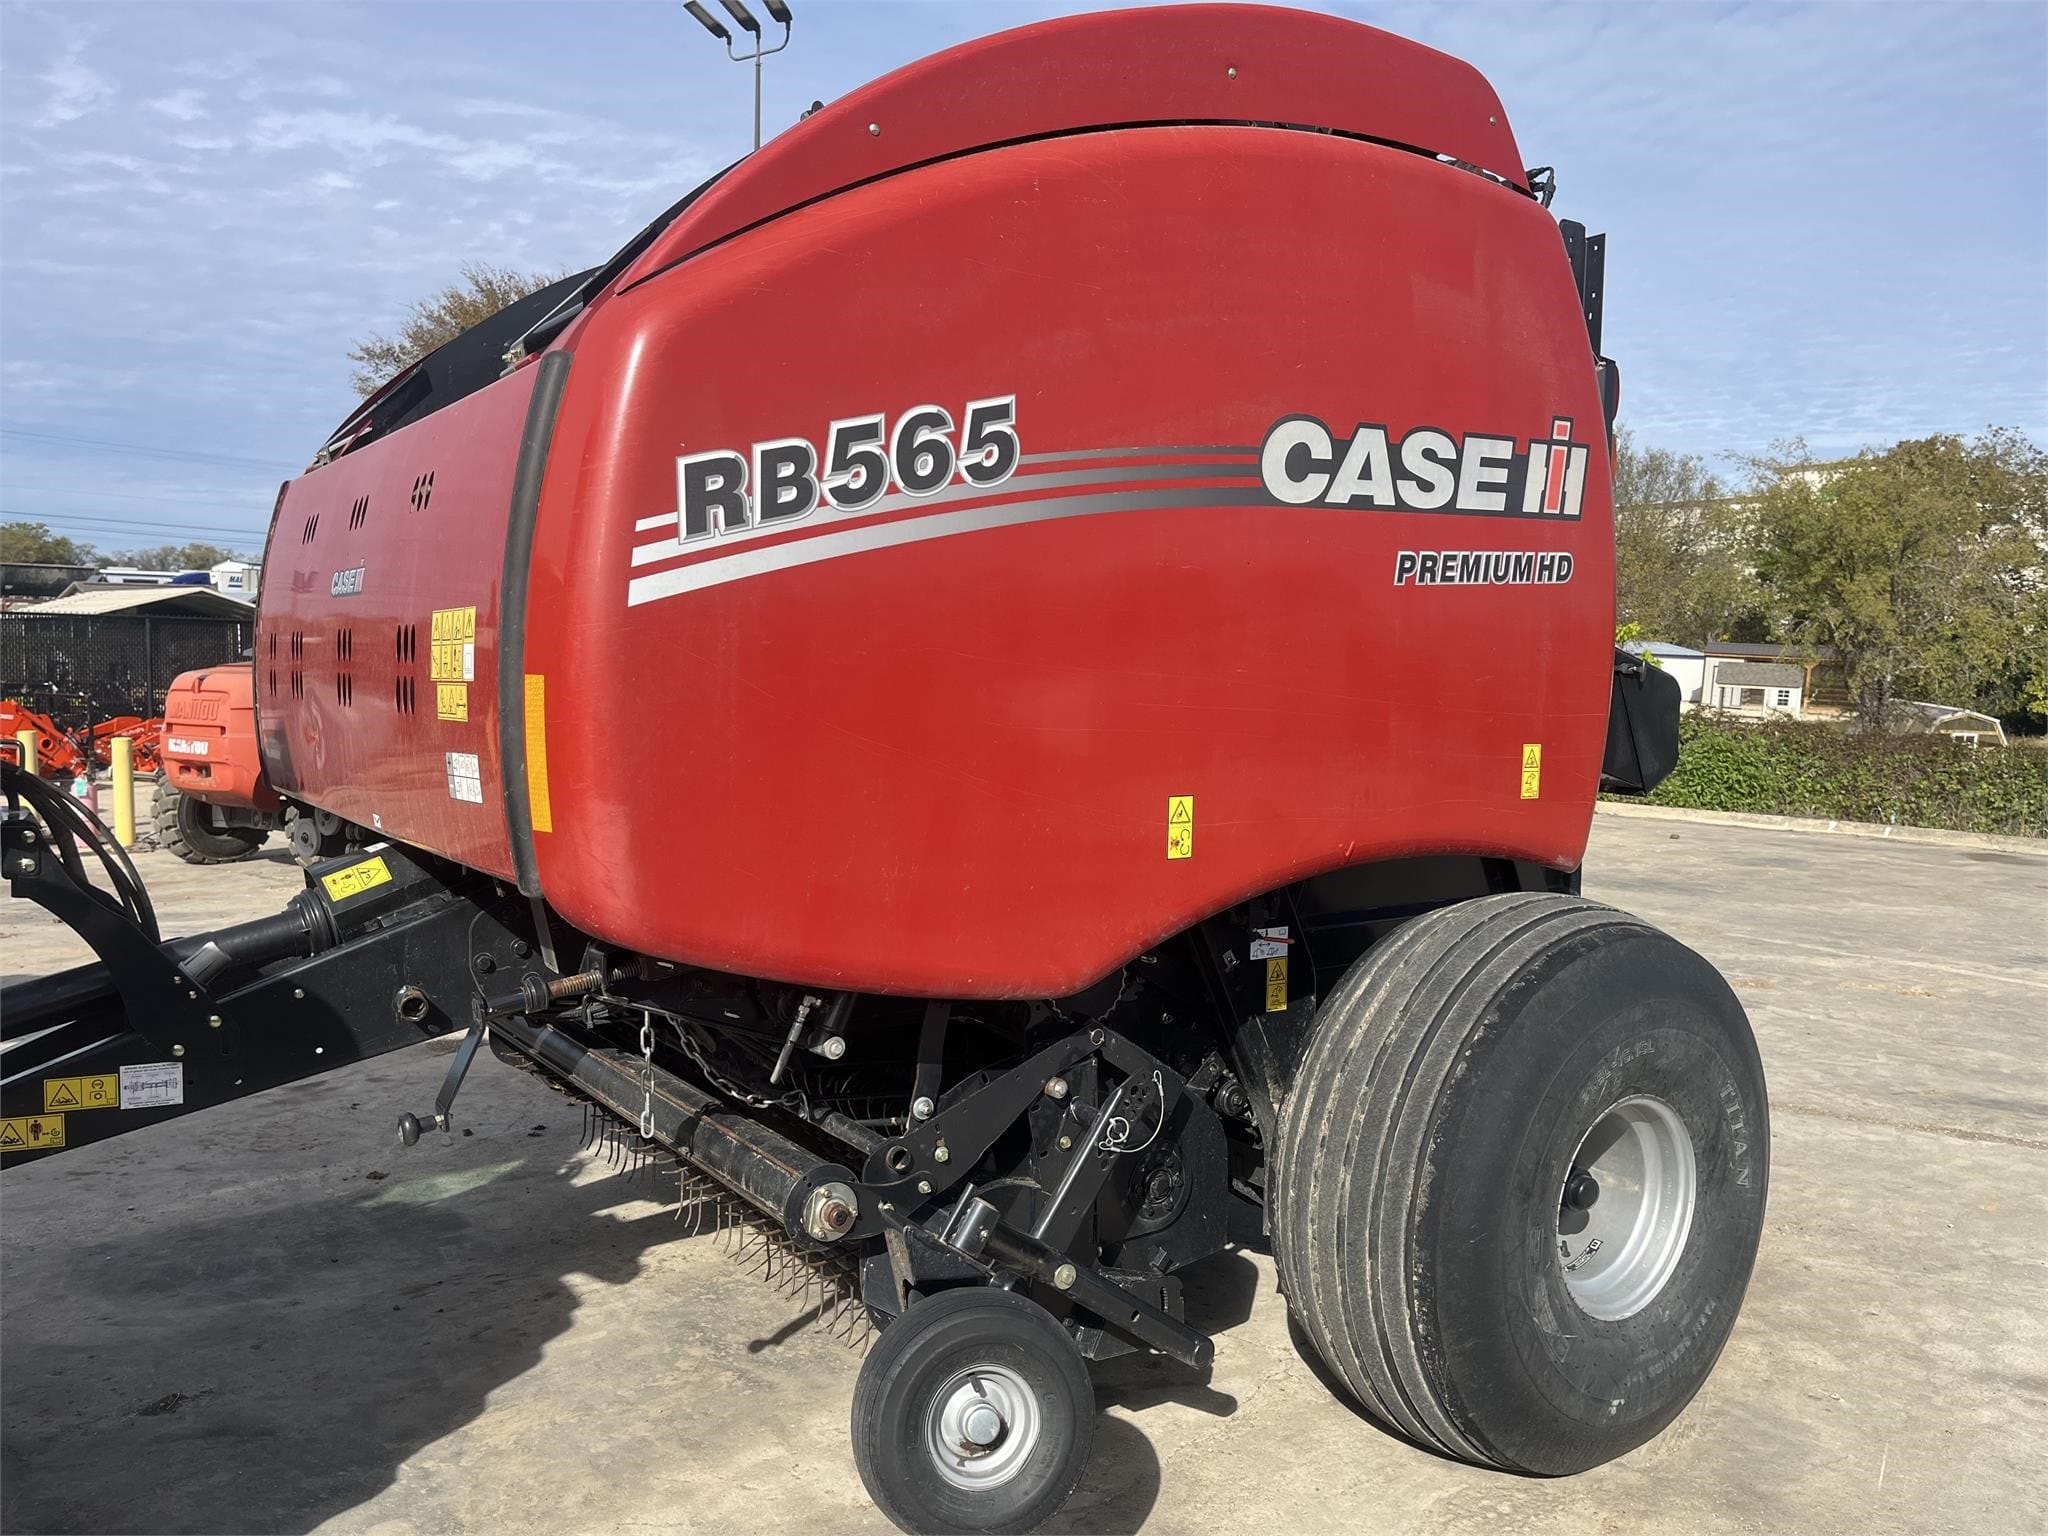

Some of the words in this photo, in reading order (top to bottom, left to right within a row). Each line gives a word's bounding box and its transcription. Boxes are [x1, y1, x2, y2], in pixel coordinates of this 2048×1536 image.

[676, 395, 1021, 545] RB565
[1261, 419, 1514, 512] CASE
[331, 570, 357, 596] CASE
[1394, 551, 1534, 585] PREMIUM
[1720, 1083, 1749, 1189] TITAN
